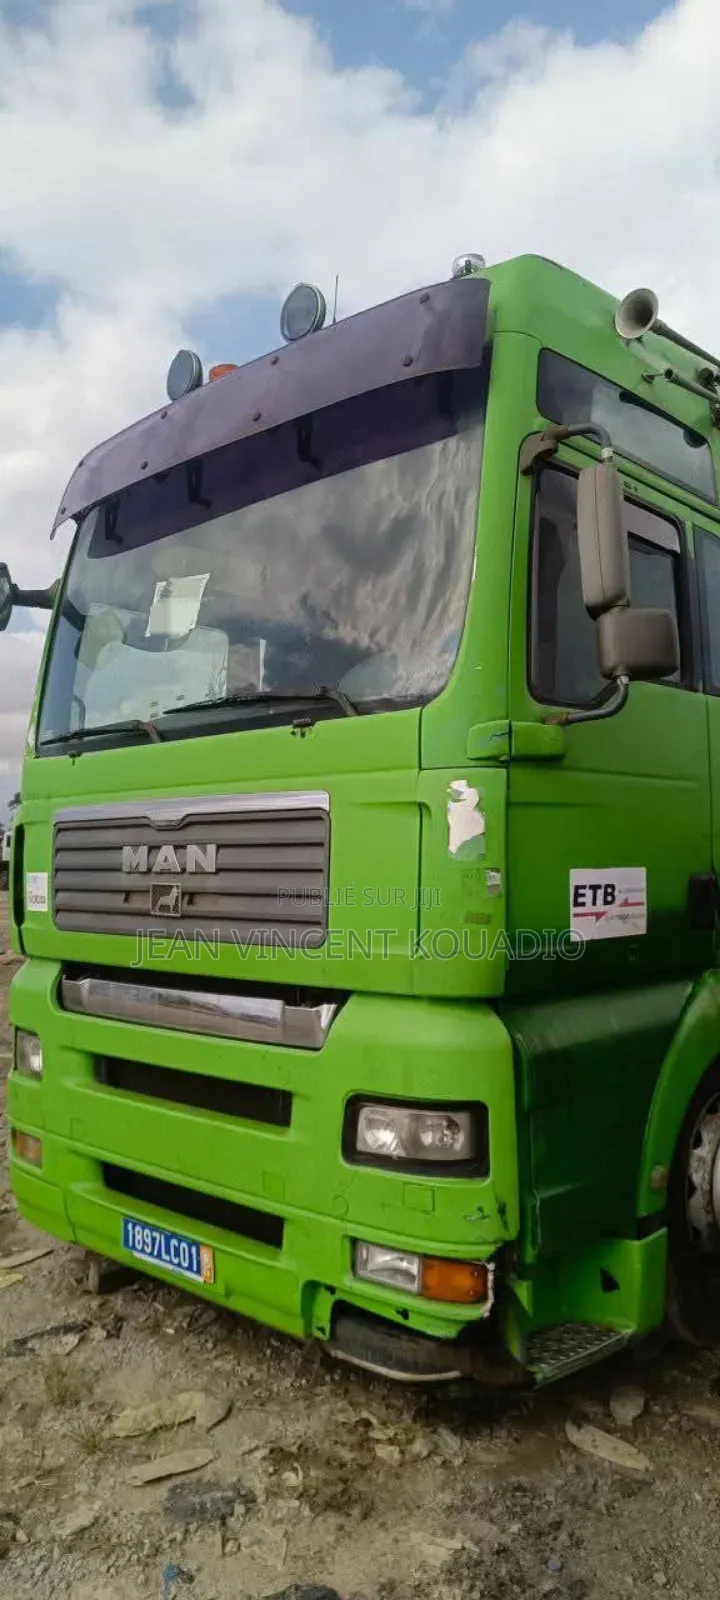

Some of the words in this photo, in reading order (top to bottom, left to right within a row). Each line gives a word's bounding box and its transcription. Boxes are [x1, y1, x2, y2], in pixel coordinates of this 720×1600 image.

[122, 844, 217, 873] MAN
[573, 884, 616, 908] ETB
[127, 1221, 198, 1272] 1897LC01
